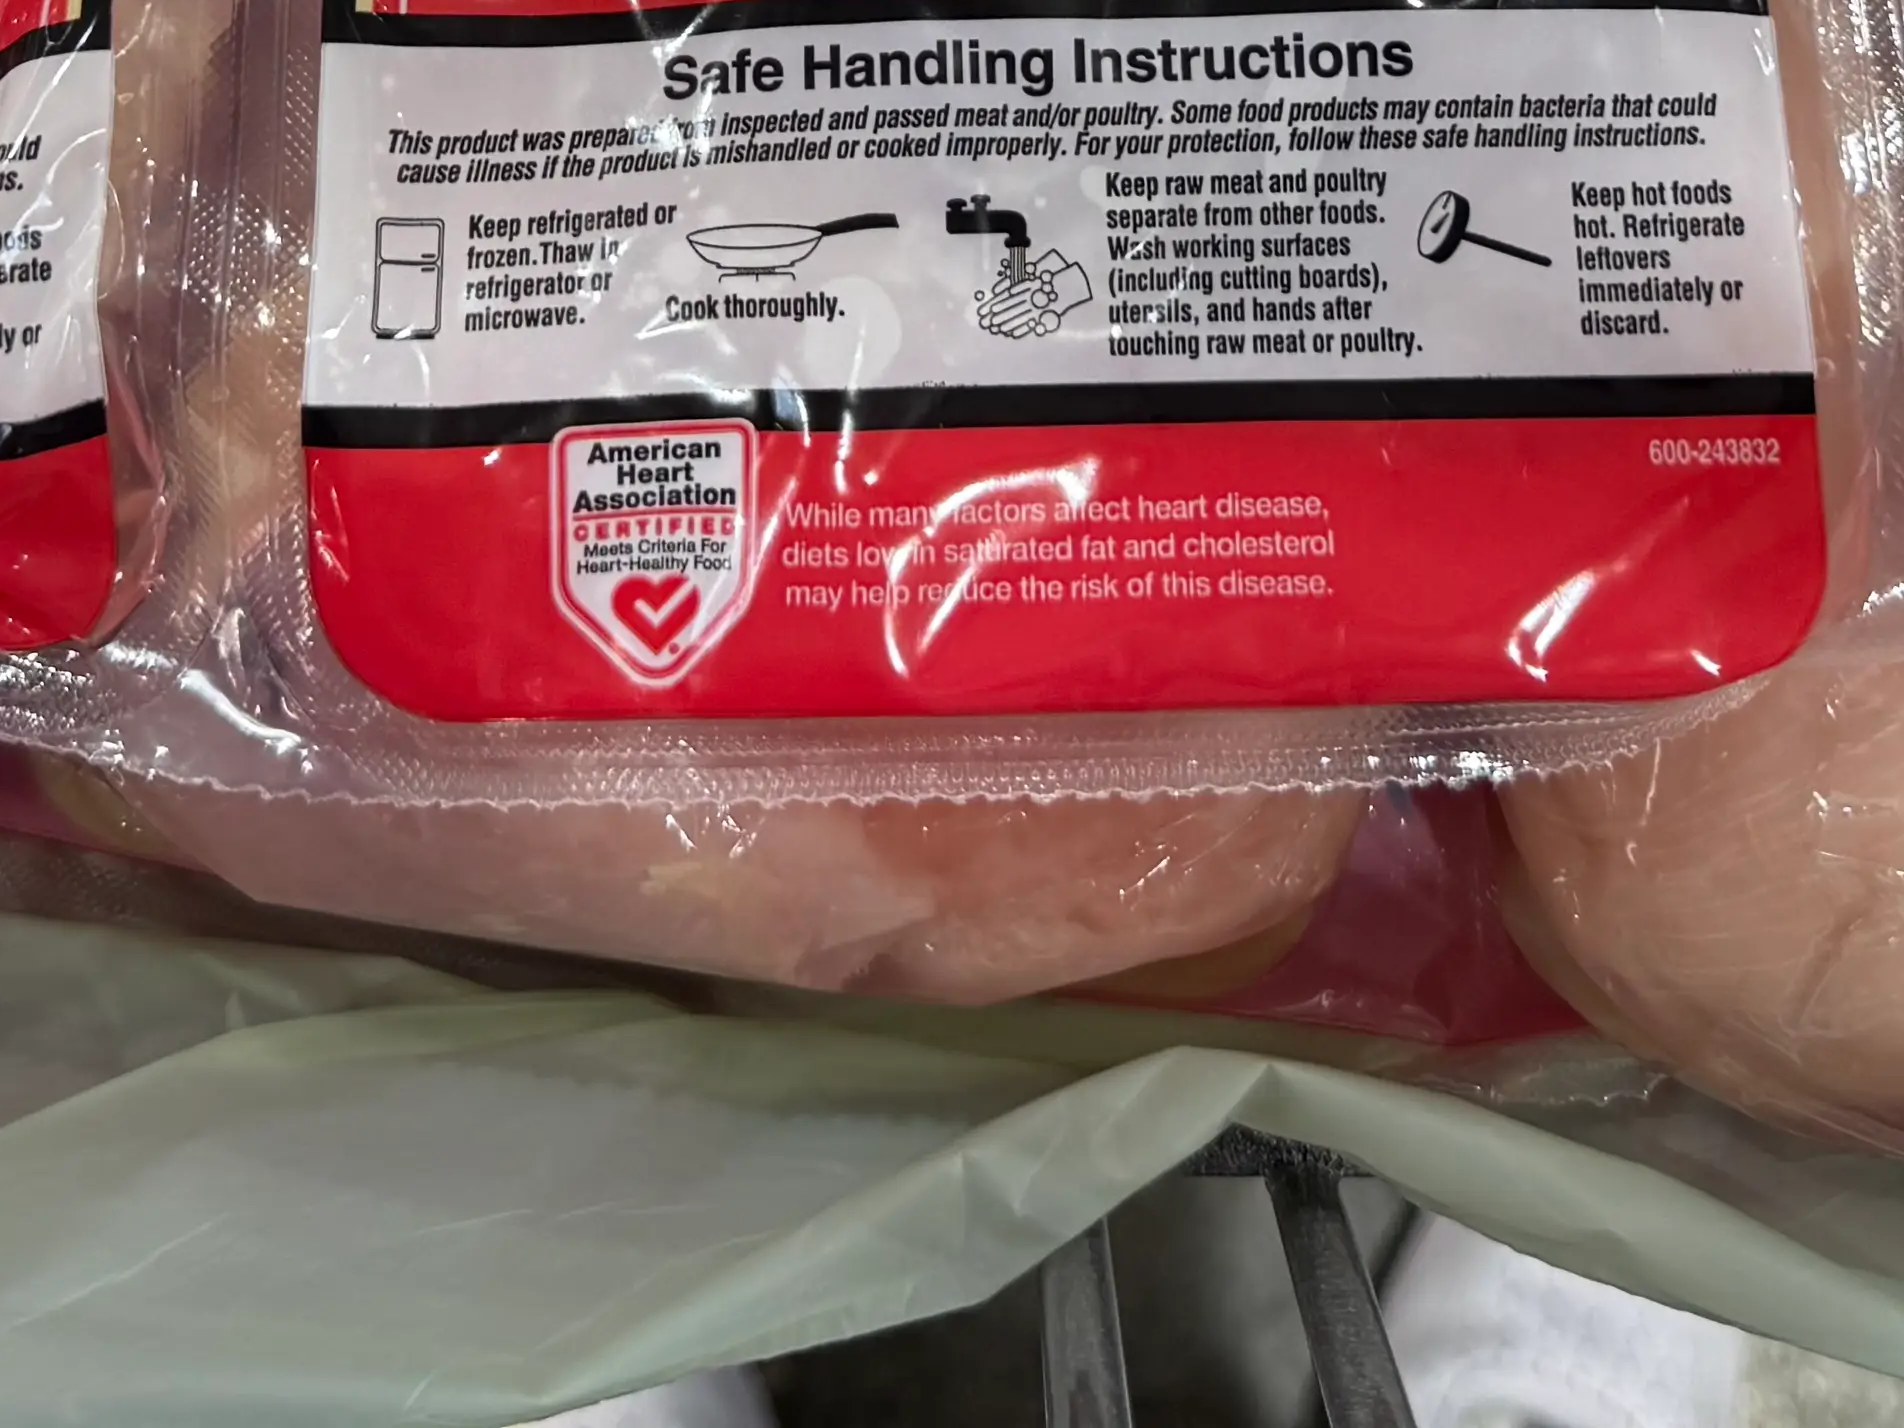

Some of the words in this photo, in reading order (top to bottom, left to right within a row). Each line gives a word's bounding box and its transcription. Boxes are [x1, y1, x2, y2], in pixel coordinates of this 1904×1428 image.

[662, 49, 785, 101] Safe
[804, 38, 1055, 96] Handling
[1073, 31, 1415, 84] Instructions
[1106, 169, 1160, 201] Keep
[1165, 173, 1204, 196] raw
[1210, 169, 1264, 195] meat
[1269, 168, 1307, 194] and
[1313, 167, 1387, 198] poultry
[1571, 181, 1626, 210] Keep
[1631, 180, 1666, 206] hot
[1670, 179, 1733, 205] foods
[587, 439, 722, 465] American
[1649, 437, 1781, 465] 600-243832
[617, 461, 695, 485] Heart
[573, 483, 737, 513] Association
[584, 541, 633, 558] Meets
[639, 538, 696, 554] Criteria
[701, 538, 727, 553] For
